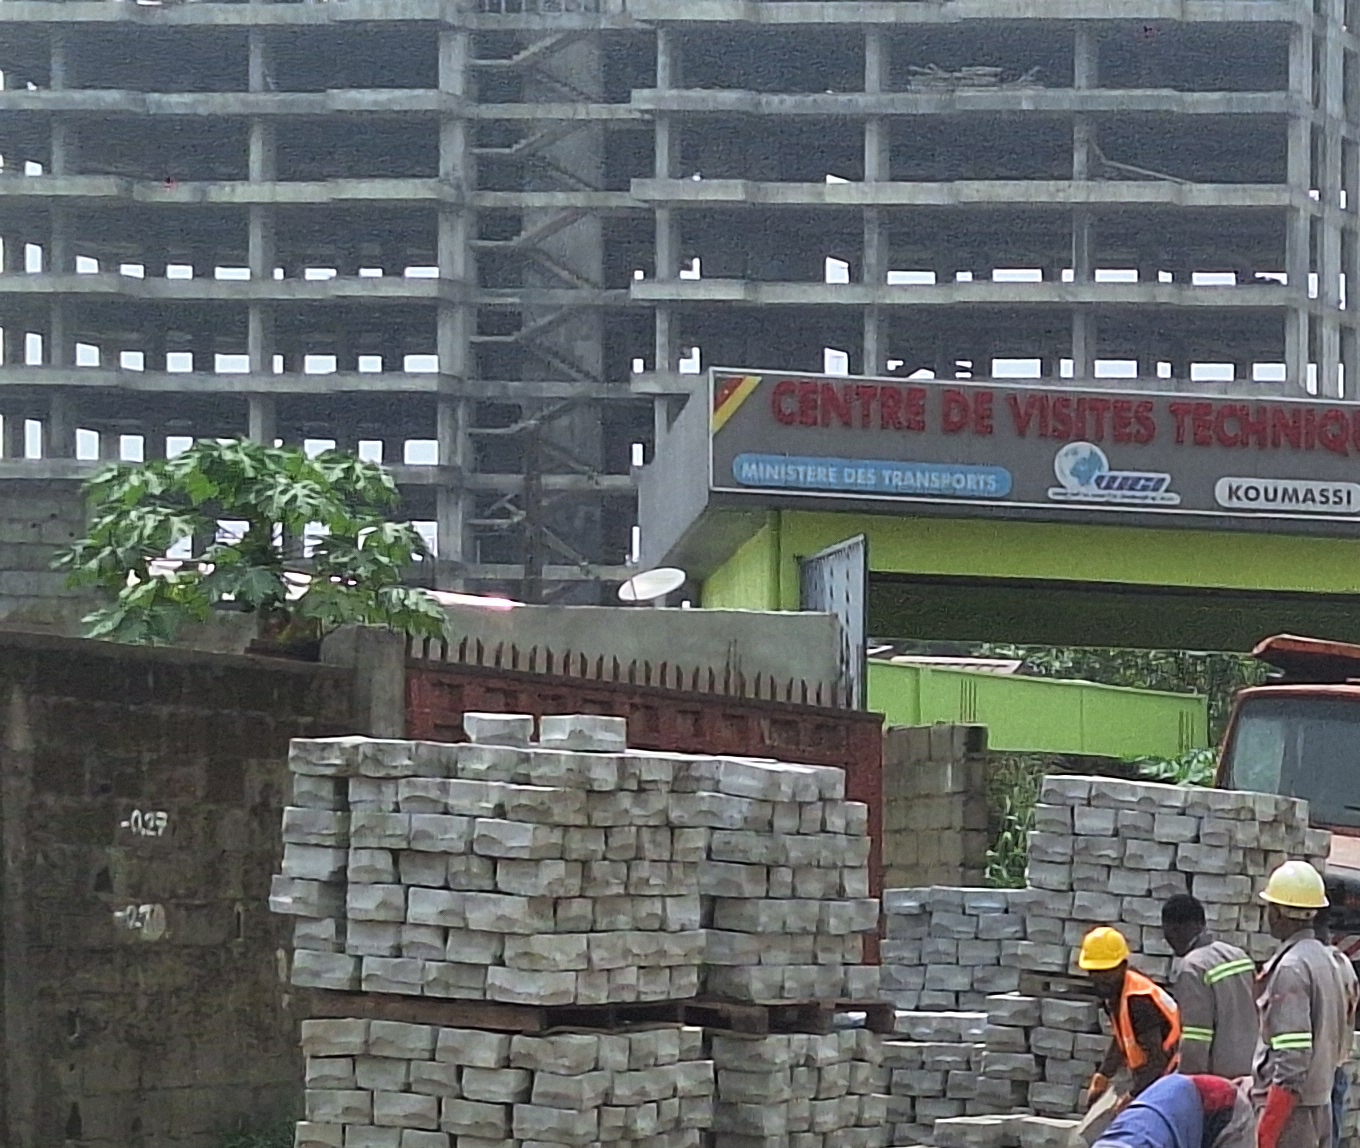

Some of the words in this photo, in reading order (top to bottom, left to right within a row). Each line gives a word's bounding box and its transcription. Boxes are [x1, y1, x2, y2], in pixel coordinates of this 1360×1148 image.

[771, 380, 927, 433] CENTRE
[942, 388, 994, 436] DE
[1008, 391, 1157, 444] VISITES
[741, 461, 837, 483] MINISTERE
[843, 466, 877, 486] DES
[882, 470, 998, 491] TRANSPORTS
[1228, 483, 1352, 506] KOUMASSI
